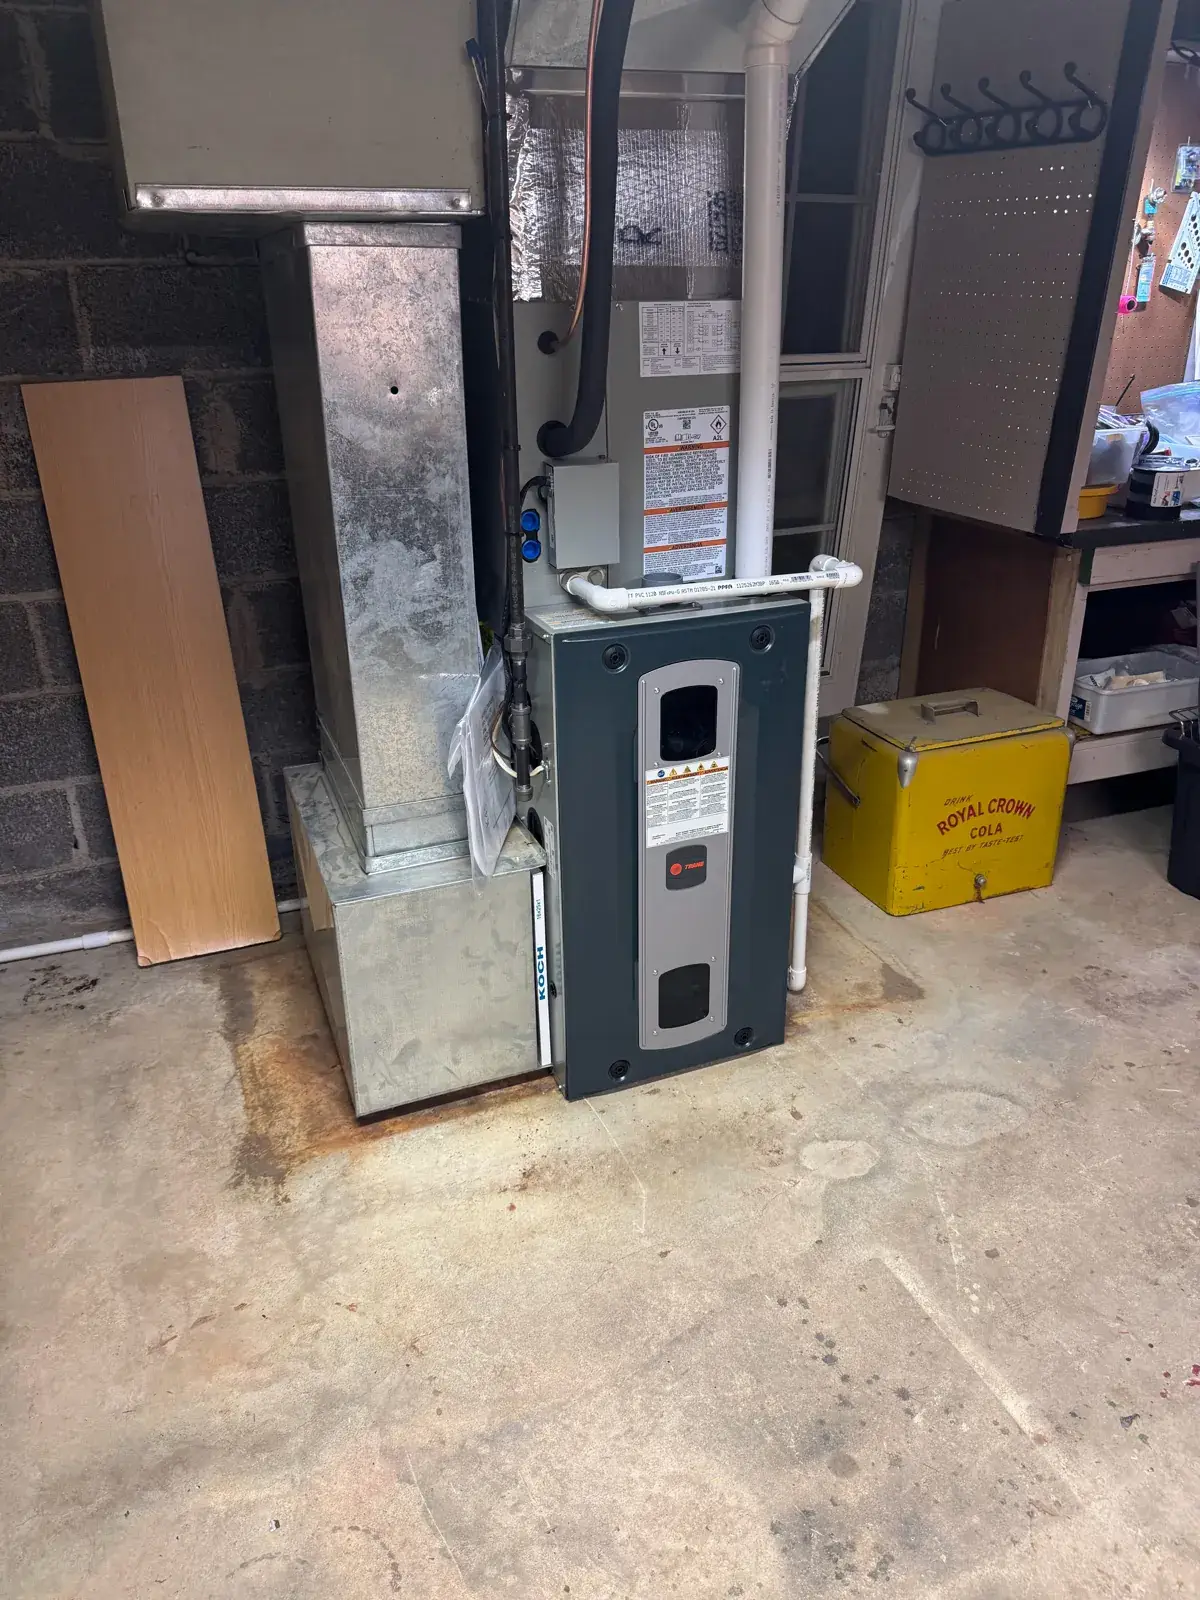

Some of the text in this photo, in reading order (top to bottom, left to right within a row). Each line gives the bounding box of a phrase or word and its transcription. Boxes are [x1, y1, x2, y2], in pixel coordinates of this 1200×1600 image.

[944, 794, 974, 806] DRINK
[936, 798, 1035, 835] ROYAL CROWN
[970, 822, 1002, 839] COLA
[942, 835, 1024, 857] BEST BY TASTE-TEST
[684, 861, 704, 870] TRANE
[537, 947, 545, 1000] KOCH
